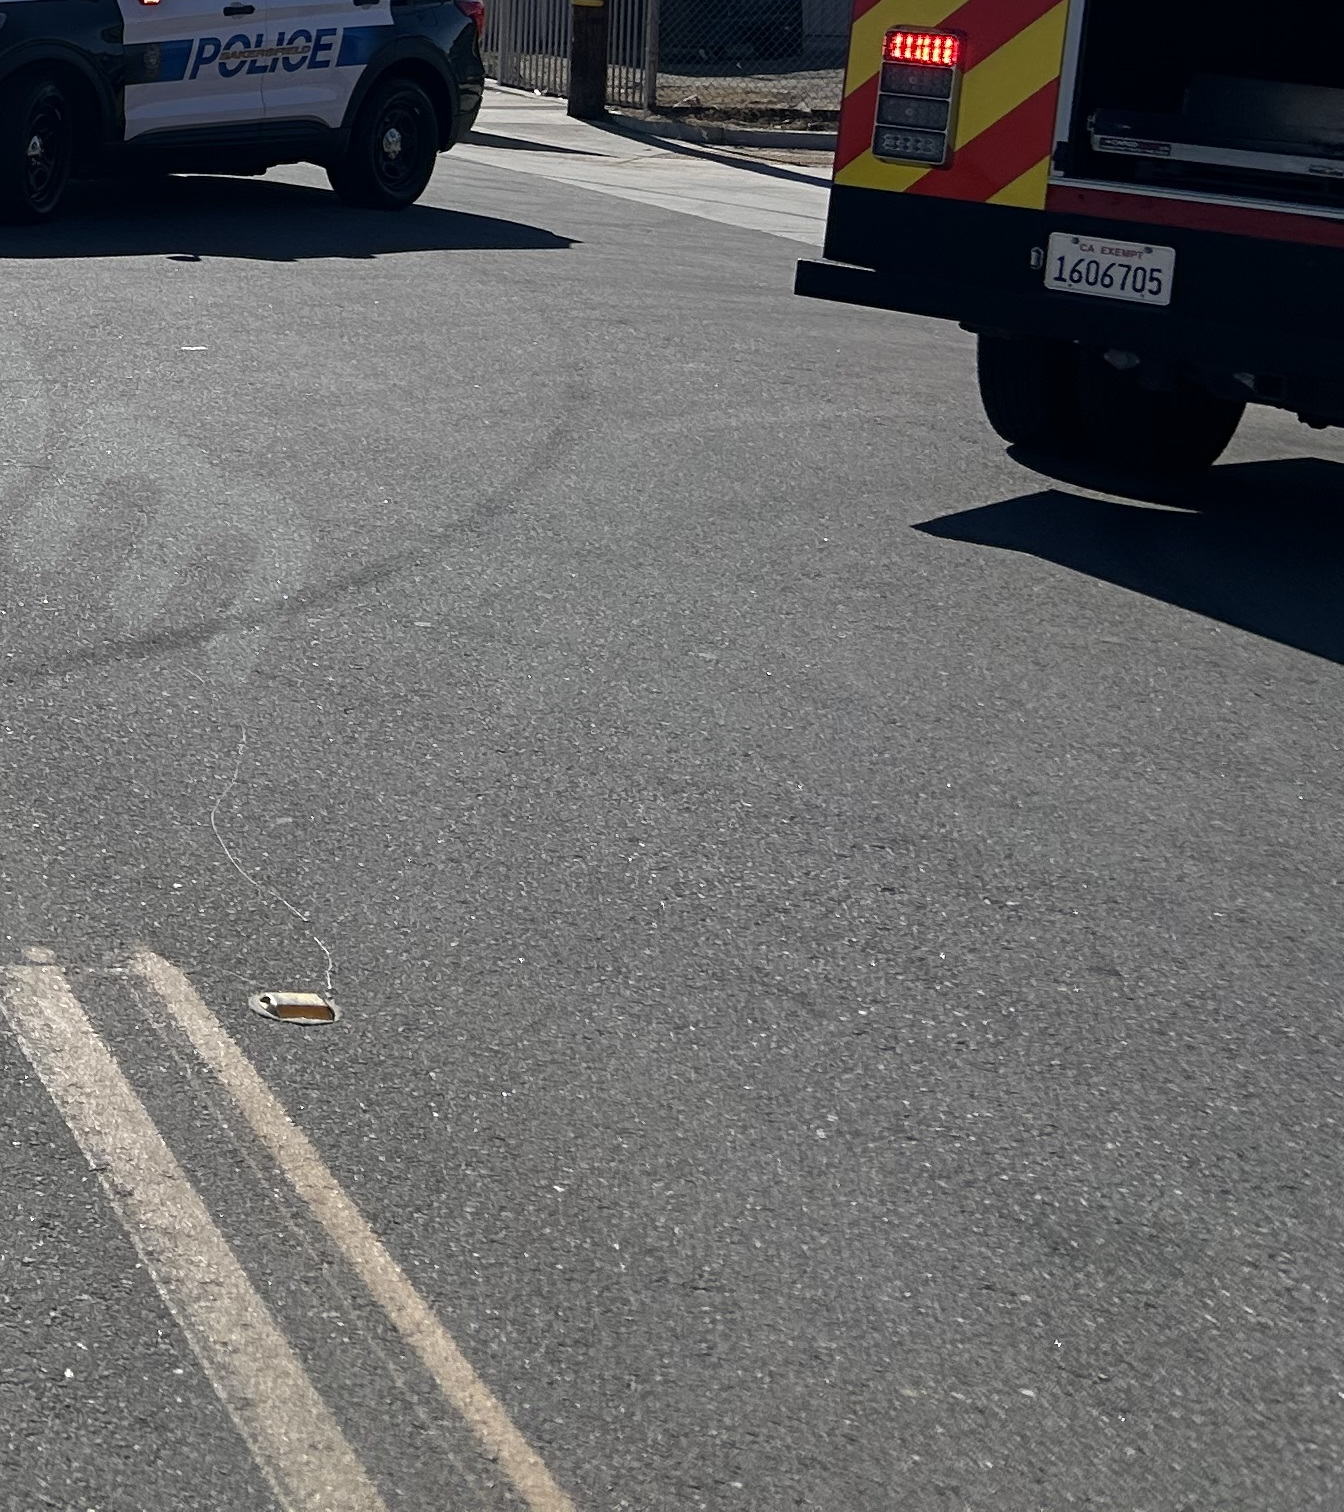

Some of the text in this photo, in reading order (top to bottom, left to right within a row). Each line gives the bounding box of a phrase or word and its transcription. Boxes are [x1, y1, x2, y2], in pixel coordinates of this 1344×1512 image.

[188, 27, 337, 81] POLICE
[219, 44, 311, 61] BAKERSFIELD
[1079, 242, 1145, 260] CA EXEMPT
[1053, 255, 1162, 296] 1606705
